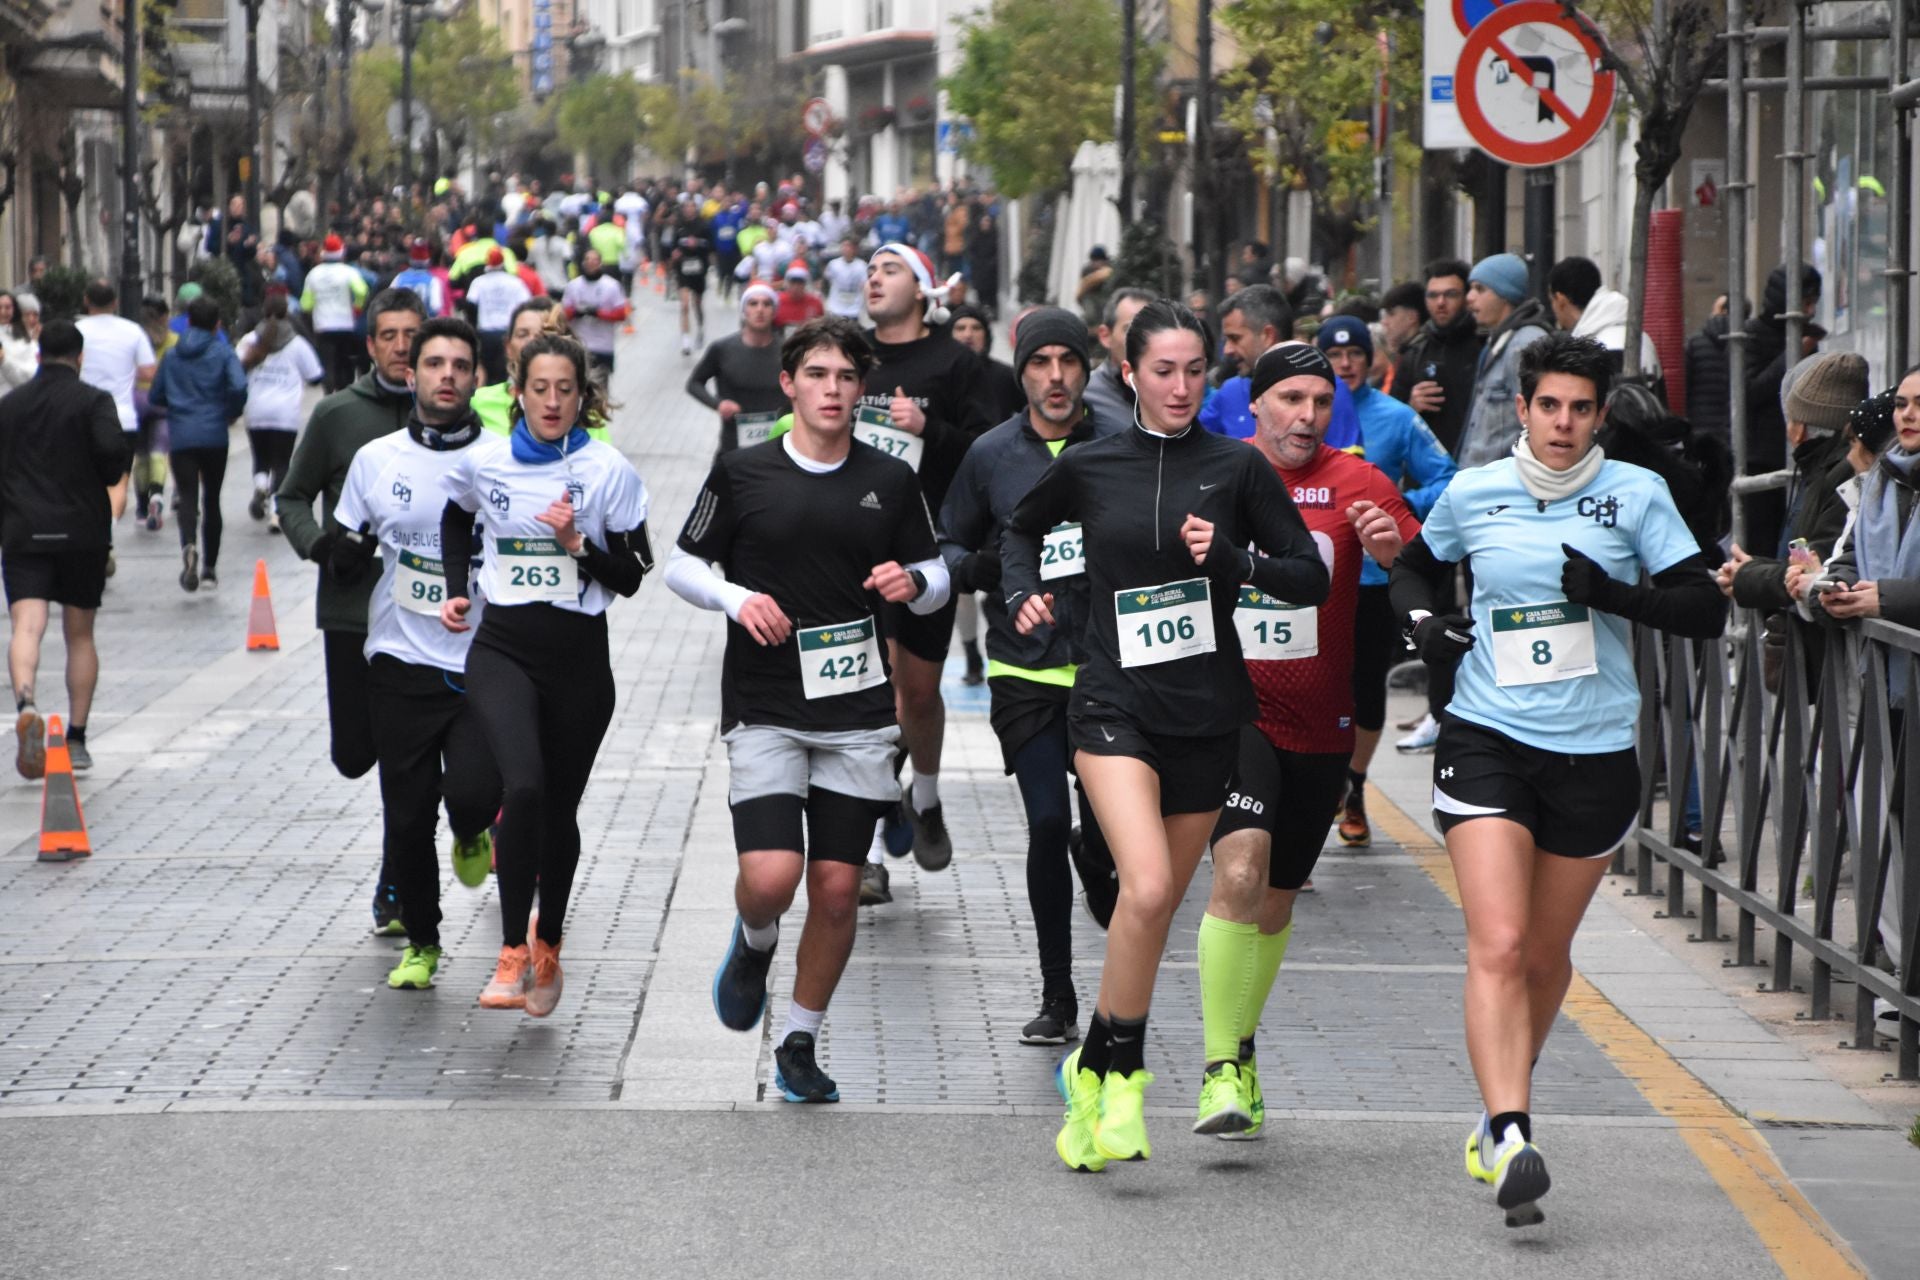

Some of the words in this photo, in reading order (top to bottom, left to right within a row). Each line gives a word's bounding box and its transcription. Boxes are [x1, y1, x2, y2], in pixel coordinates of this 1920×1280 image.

[1293, 487, 1330, 503] 360
[392, 530, 410, 546] SAN
[412, 533, 441, 547] SILVE
[510, 565, 561, 586] 263
[411, 580, 443, 603] 98
[1136, 615, 1196, 648] 106
[1253, 620, 1292, 645] 15
[1531, 639, 1553, 665] 8
[819, 652, 869, 680] 422
[1226, 792, 1264, 815] 360
